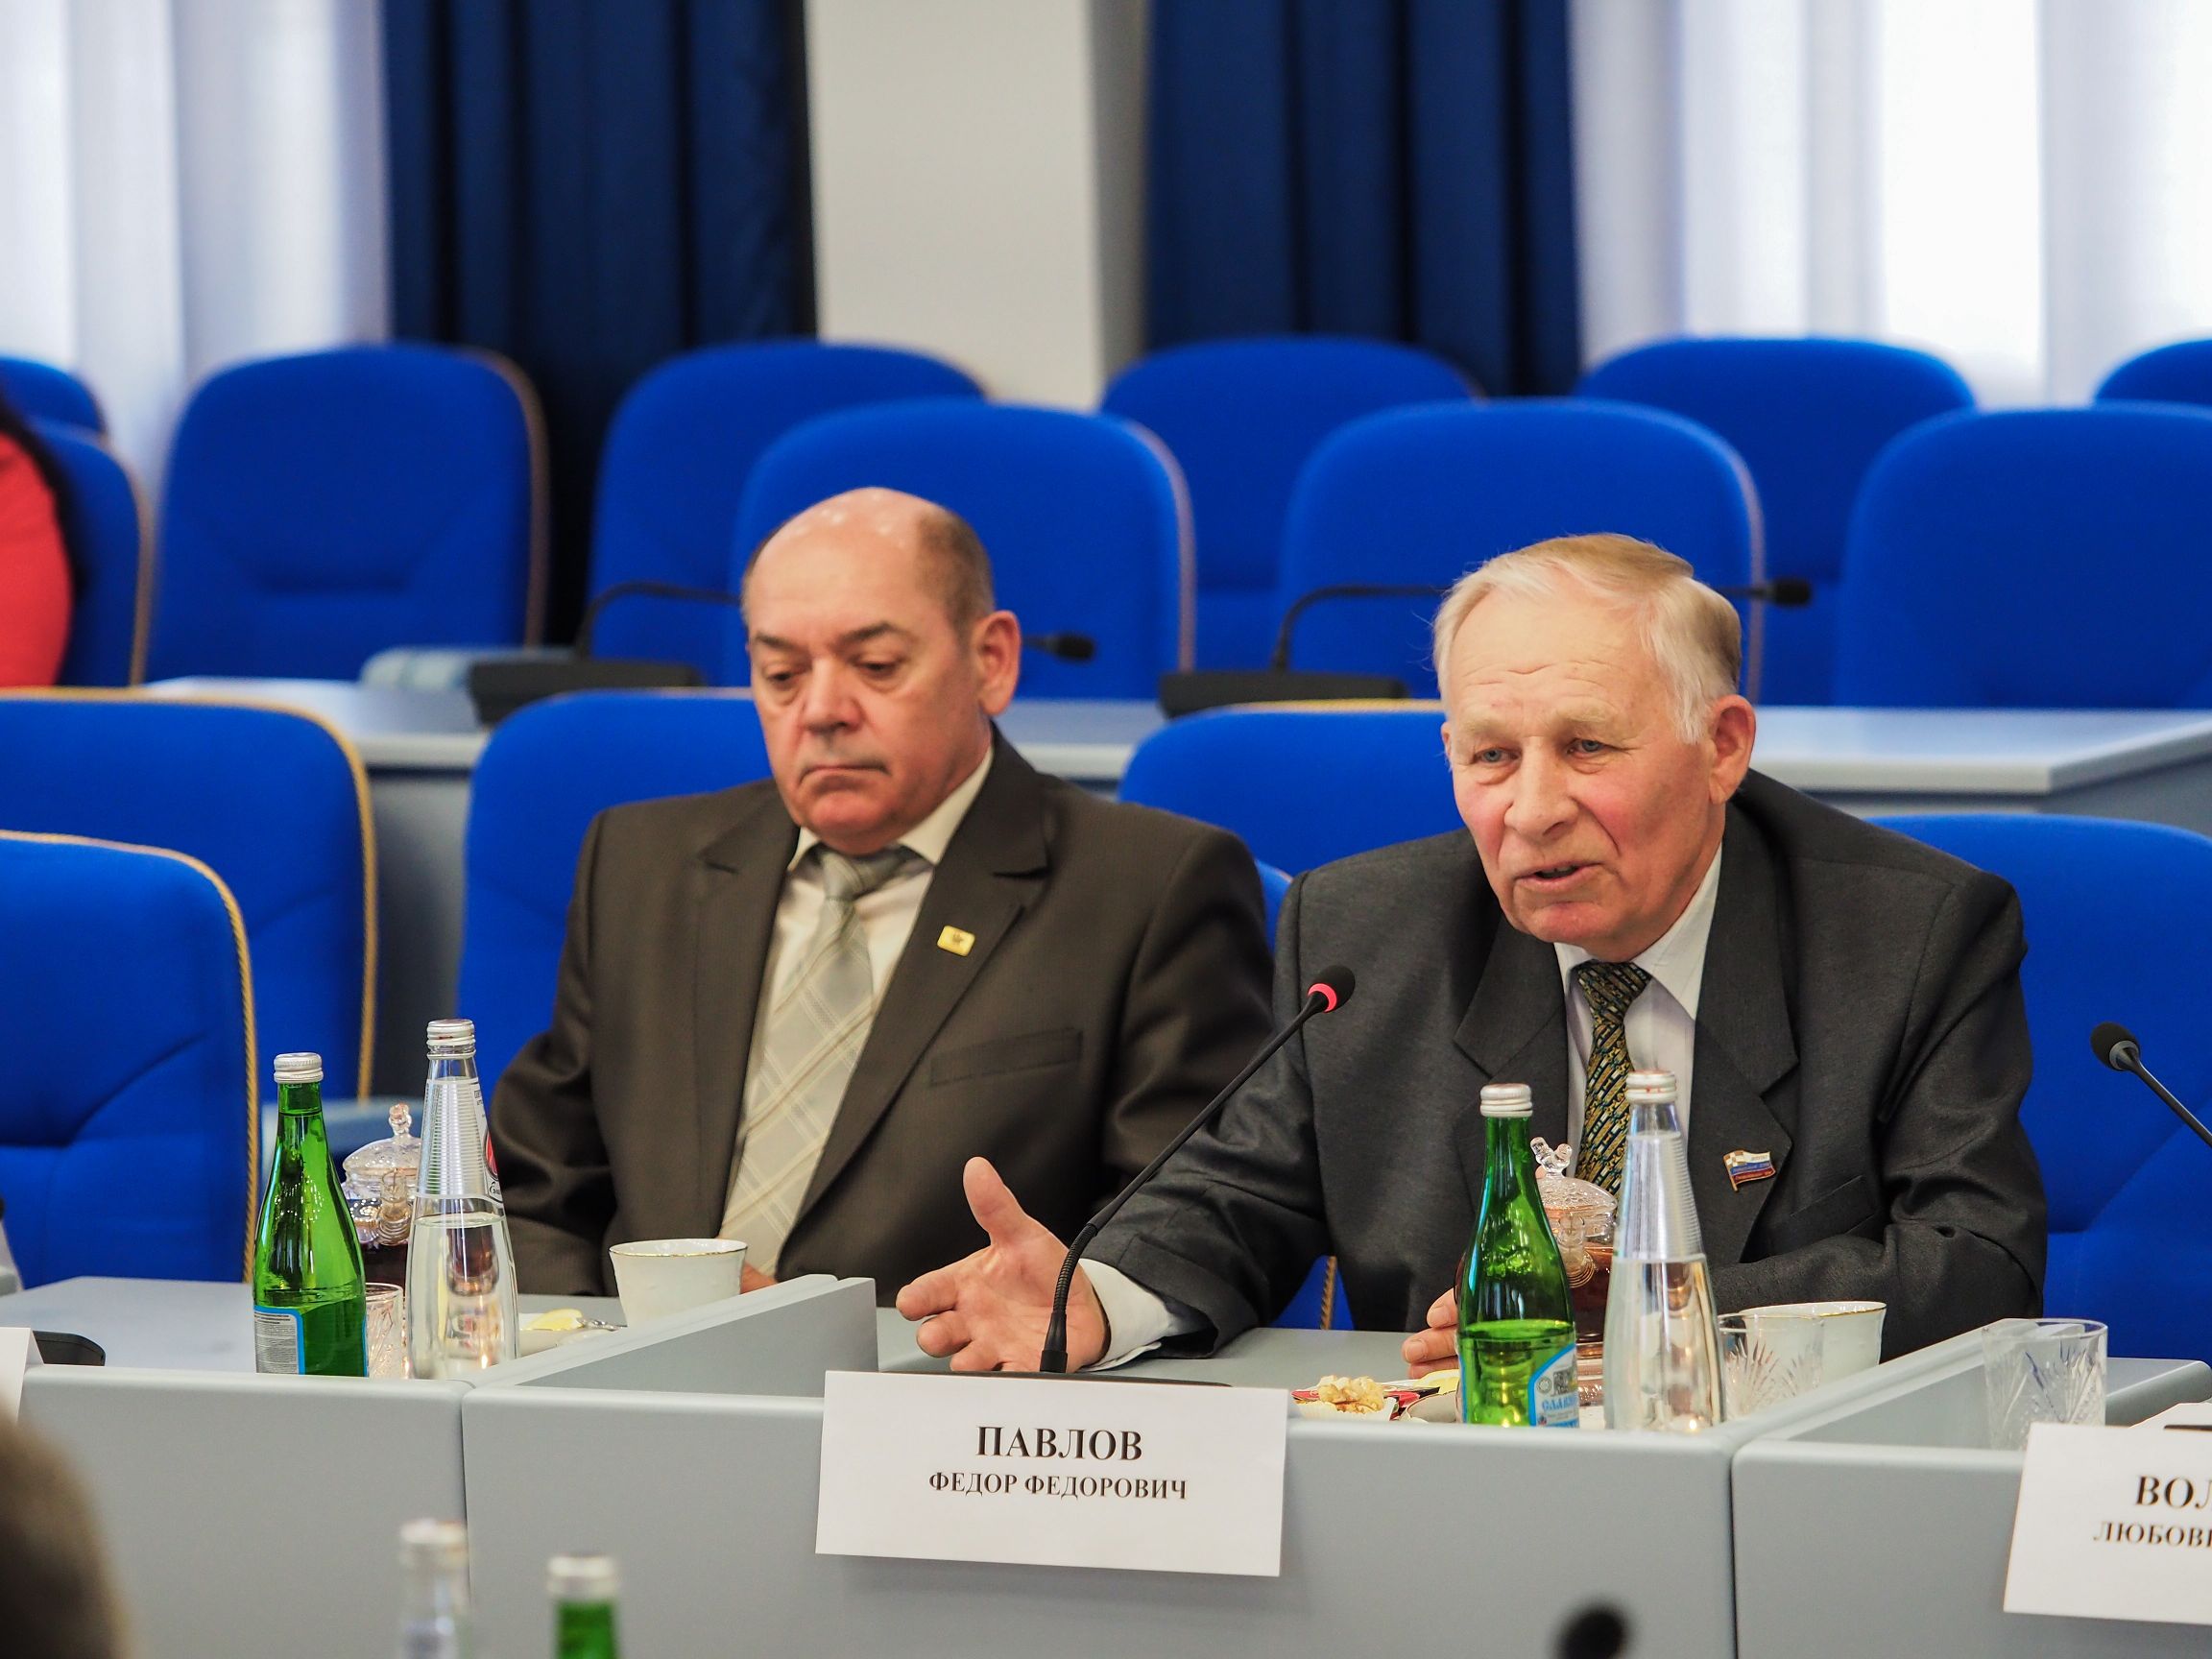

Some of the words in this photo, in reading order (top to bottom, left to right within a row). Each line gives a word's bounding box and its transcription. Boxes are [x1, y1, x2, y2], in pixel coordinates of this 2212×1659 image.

[976, 1426, 1142, 1461] ПАВЛОВ
[928, 1472, 1018, 1497] ФЕДОР
[1024, 1475, 1187, 1500] ФЕДОРОВИЧ
